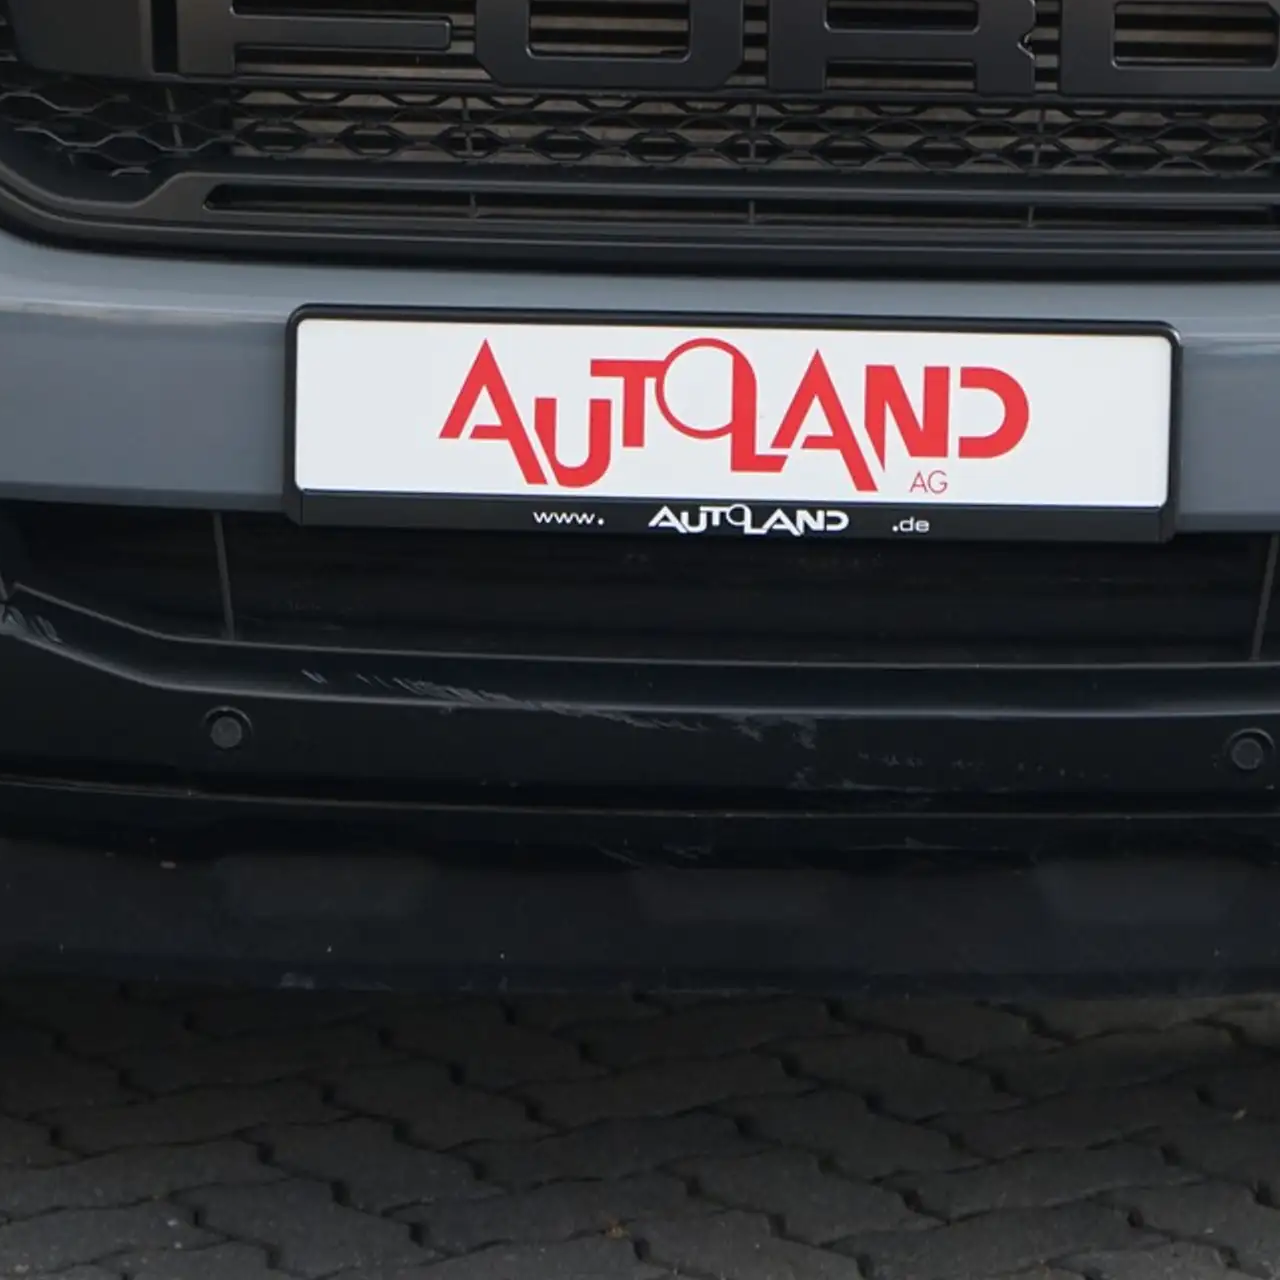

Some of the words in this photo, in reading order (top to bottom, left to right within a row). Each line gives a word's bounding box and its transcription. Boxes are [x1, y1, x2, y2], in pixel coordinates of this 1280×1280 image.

[438, 336, 1031, 495] AUTOLAND
[908, 469, 950, 495] AG
[647, 503, 851, 537] AUTOLAND
[891, 515, 931, 534] .de
